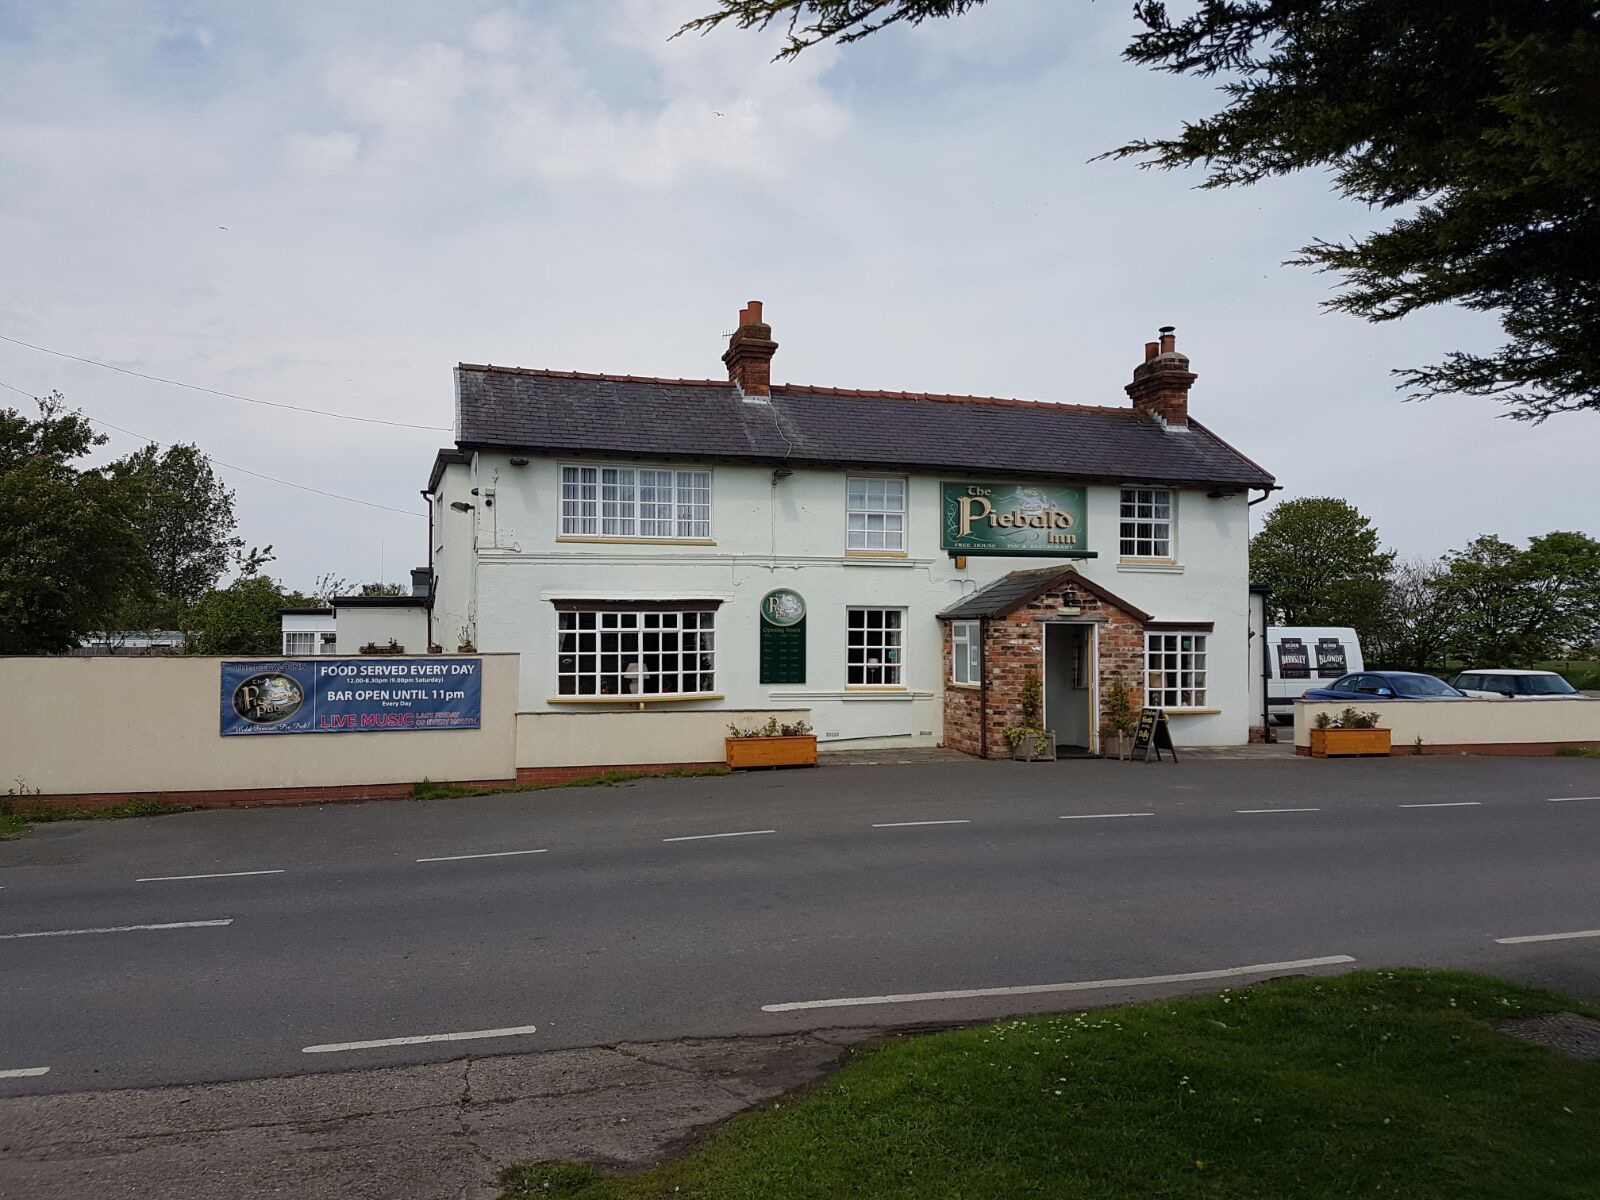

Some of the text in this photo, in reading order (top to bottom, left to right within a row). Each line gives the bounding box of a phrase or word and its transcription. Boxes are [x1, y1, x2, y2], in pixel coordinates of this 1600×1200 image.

[967, 486, 992, 497] The
[956, 496, 1074, 538] Piebald
[1047, 530, 1077, 545] Inn
[1281, 655, 1306, 665] BARNSLEY
[1318, 655, 1345, 665] BLONDE
[321, 664, 475, 676] FOOD SERVED EVERY DAY
[327, 689, 465, 701] BAR OPEN UNTIL 11pm
[256, 704, 281, 719] Pub
[321, 712, 415, 728] LIVE MUSIC
